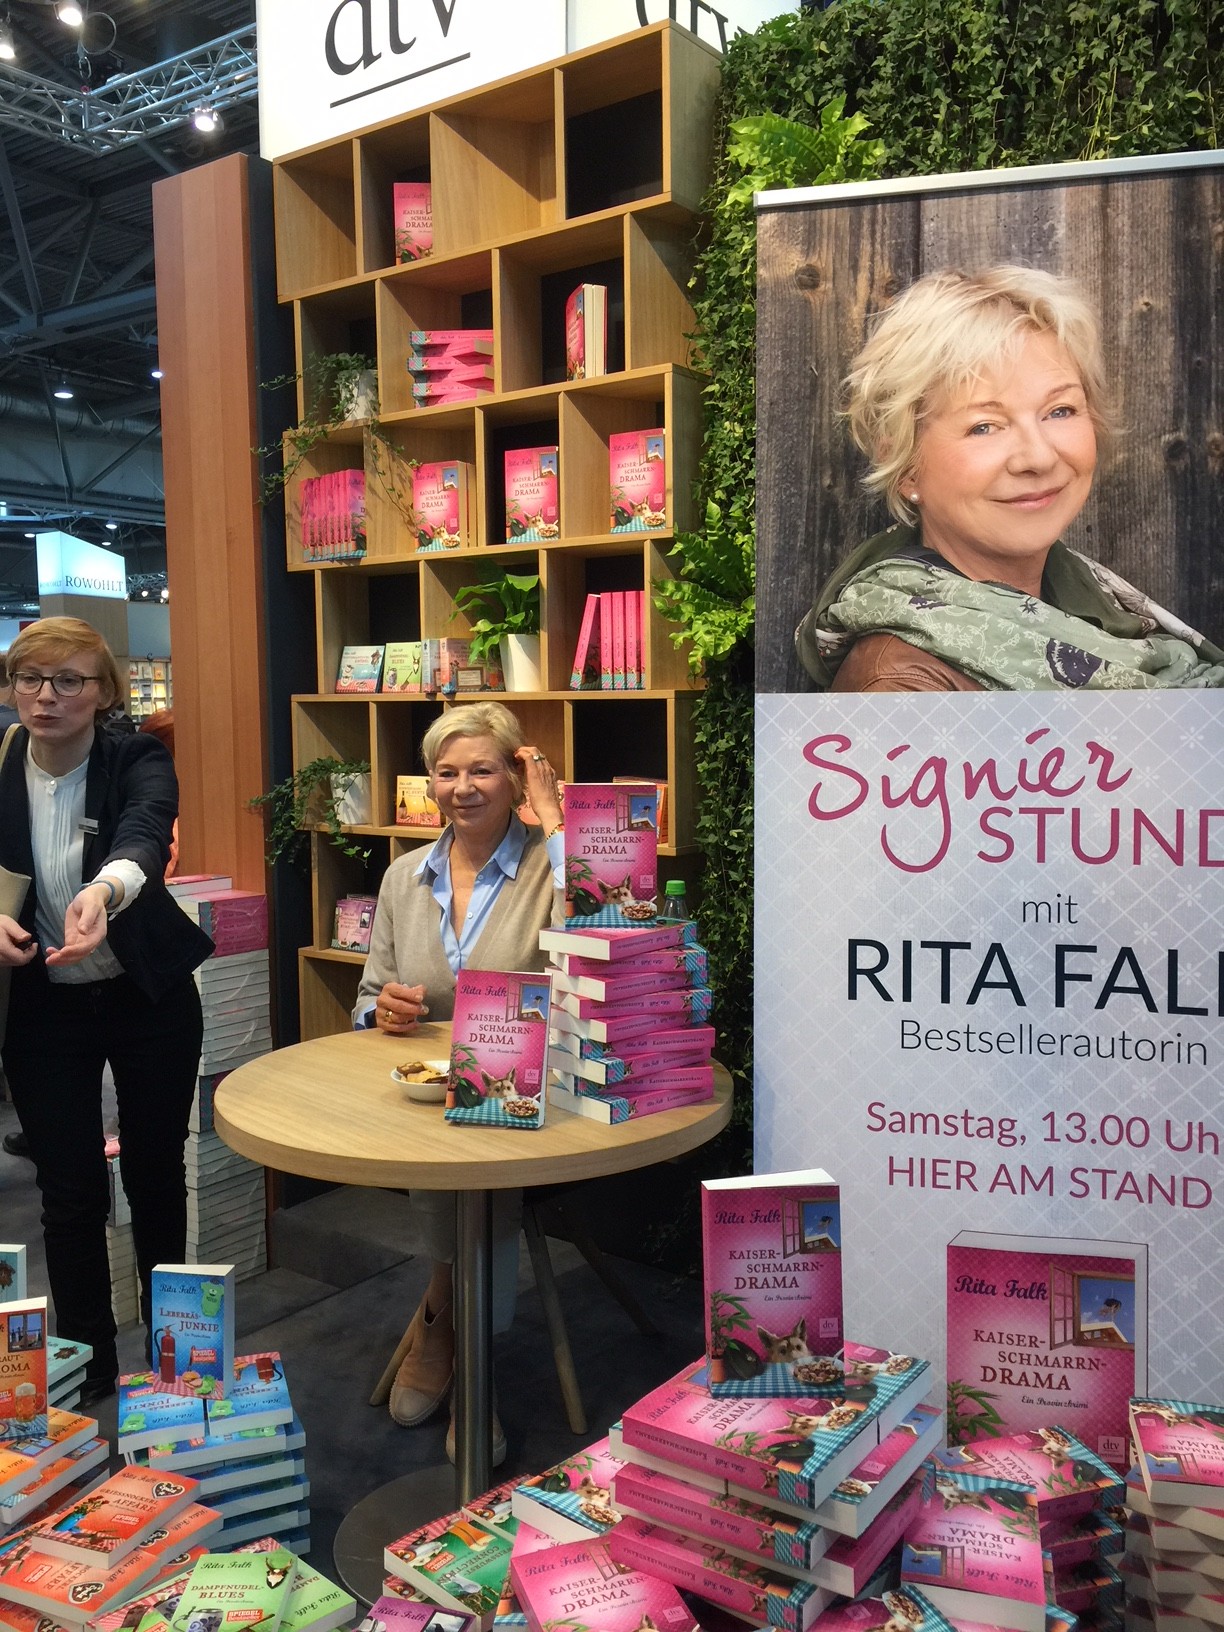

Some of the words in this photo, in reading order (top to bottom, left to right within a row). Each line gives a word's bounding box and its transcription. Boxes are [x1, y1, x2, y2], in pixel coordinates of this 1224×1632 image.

[620, 475, 646, 483] DRAMA
[514, 488, 540, 496] DRAMA
[422, 500, 444, 508] DRAMA
[65, 575, 124, 592] ROWOHLT
[569, 800, 591, 810] Rita
[594, 800, 616, 810] Falk
[803, 727, 1133, 873] Signier
[590, 836, 645, 844] SCHMARRN-
[582, 846, 628, 855] DRAMA
[1022, 893, 1079, 924] mit
[848, 938, 1027, 1007] RITA
[1054, 943, 1224, 1017] FAL
[460, 984, 482, 996] Rita
[485, 986, 508, 997] Falk
[468, 1012, 504, 1022] KAISER-
[478, 1024, 534, 1035] SCHMARRN-
[469, 1032, 515, 1046] DRAMA
[900, 1019, 1208, 1066] Bestsellerautorin
[866, 1101, 1027, 1148] Samstag,
[1042, 1110, 1150, 1148] 13.00
[888, 1156, 979, 1192] HIER
[988, 1163, 1054, 1197] AM
[1069, 1167, 1213, 1209] STAND
[714, 1210, 745, 1225] Rita
[750, 1209, 781, 1224] Falk
[729, 1249, 781, 1260] KAISER-
[746, 1261, 824, 1274] SCHMARRN-
[159, 1284, 176, 1294] Rita
[178, 1284, 198, 1294] Falk
[734, 1276, 800, 1290] DRAMA
[954, 1274, 998, 1296] Rita
[1004, 1279, 1049, 1301] Falk
[179, 1320, 220, 1332] JUNKIE
[973, 1329, 1046, 1348] KAISER-
[998, 1350, 1107, 1371] SCHMARRN-
[980, 1365, 1071, 1391] DRAMA
[1021, 1396, 1034, 1404] Ein
[1036, 1397, 1088, 1409] Provinzkrimi
[686, 1400, 720, 1425] KAISER-
[712, 1401, 756, 1432] DRAMA
[1102, 1438, 1120, 1451] dtv
[600, 1451, 624, 1466] DRA
[922, 1533, 1004, 1550] SCHMARRN-
[950, 1527, 1016, 1546] DRAMA
[966, 1547, 1022, 1562] KAISER-
[201, 1562, 225, 1570] Rita
[228, 1560, 252, 1568] Falk
[524, 1564, 556, 1578] Rita
[560, 1551, 592, 1567] Falk
[548, 1576, 601, 1597] KAISER-
[966, 1567, 1000, 1581] Falk
[1004, 1574, 1038, 1590] Rita
[571, 1576, 649, 1600] SCHMARRN-
[562, 1588, 630, 1614] DRAMA
[375, 1606, 398, 1616] Rita
[401, 1610, 427, 1622] Falk
